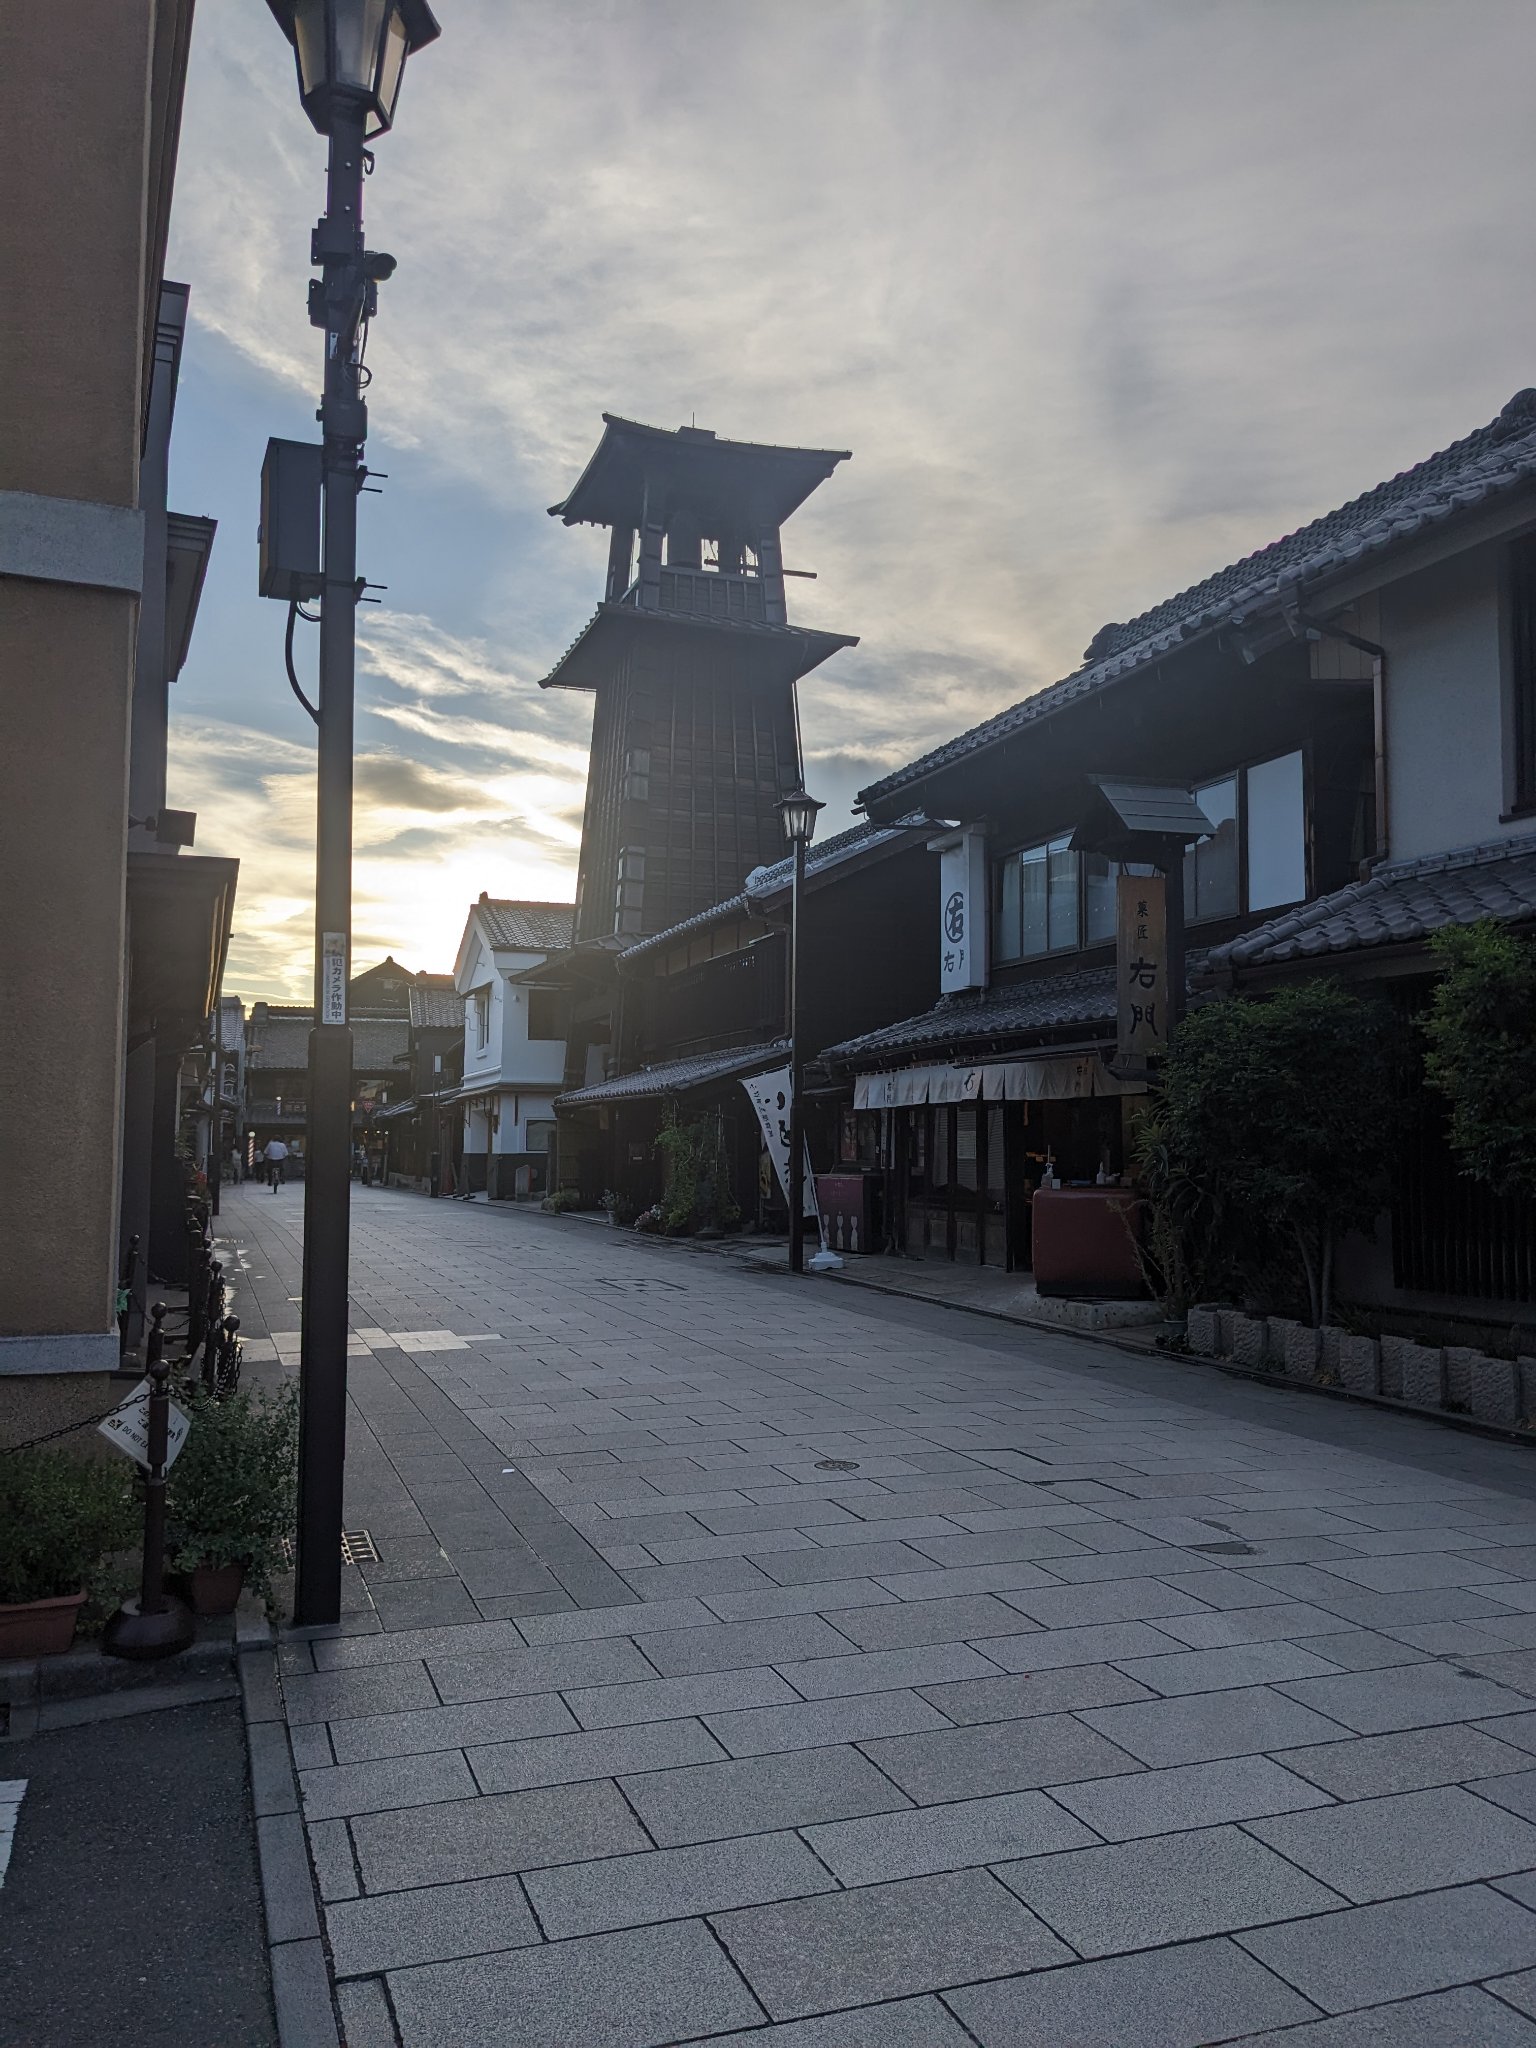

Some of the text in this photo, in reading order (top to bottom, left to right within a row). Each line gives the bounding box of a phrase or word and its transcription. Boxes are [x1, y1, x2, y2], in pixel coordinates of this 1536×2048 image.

[331, 949, 343, 1019] 犯カメラ作動中
[1129, 901, 1158, 1036] 菓匠 右門
[122, 1425, 131, 1435] DO
[131, 1433, 142, 1443] NOT
